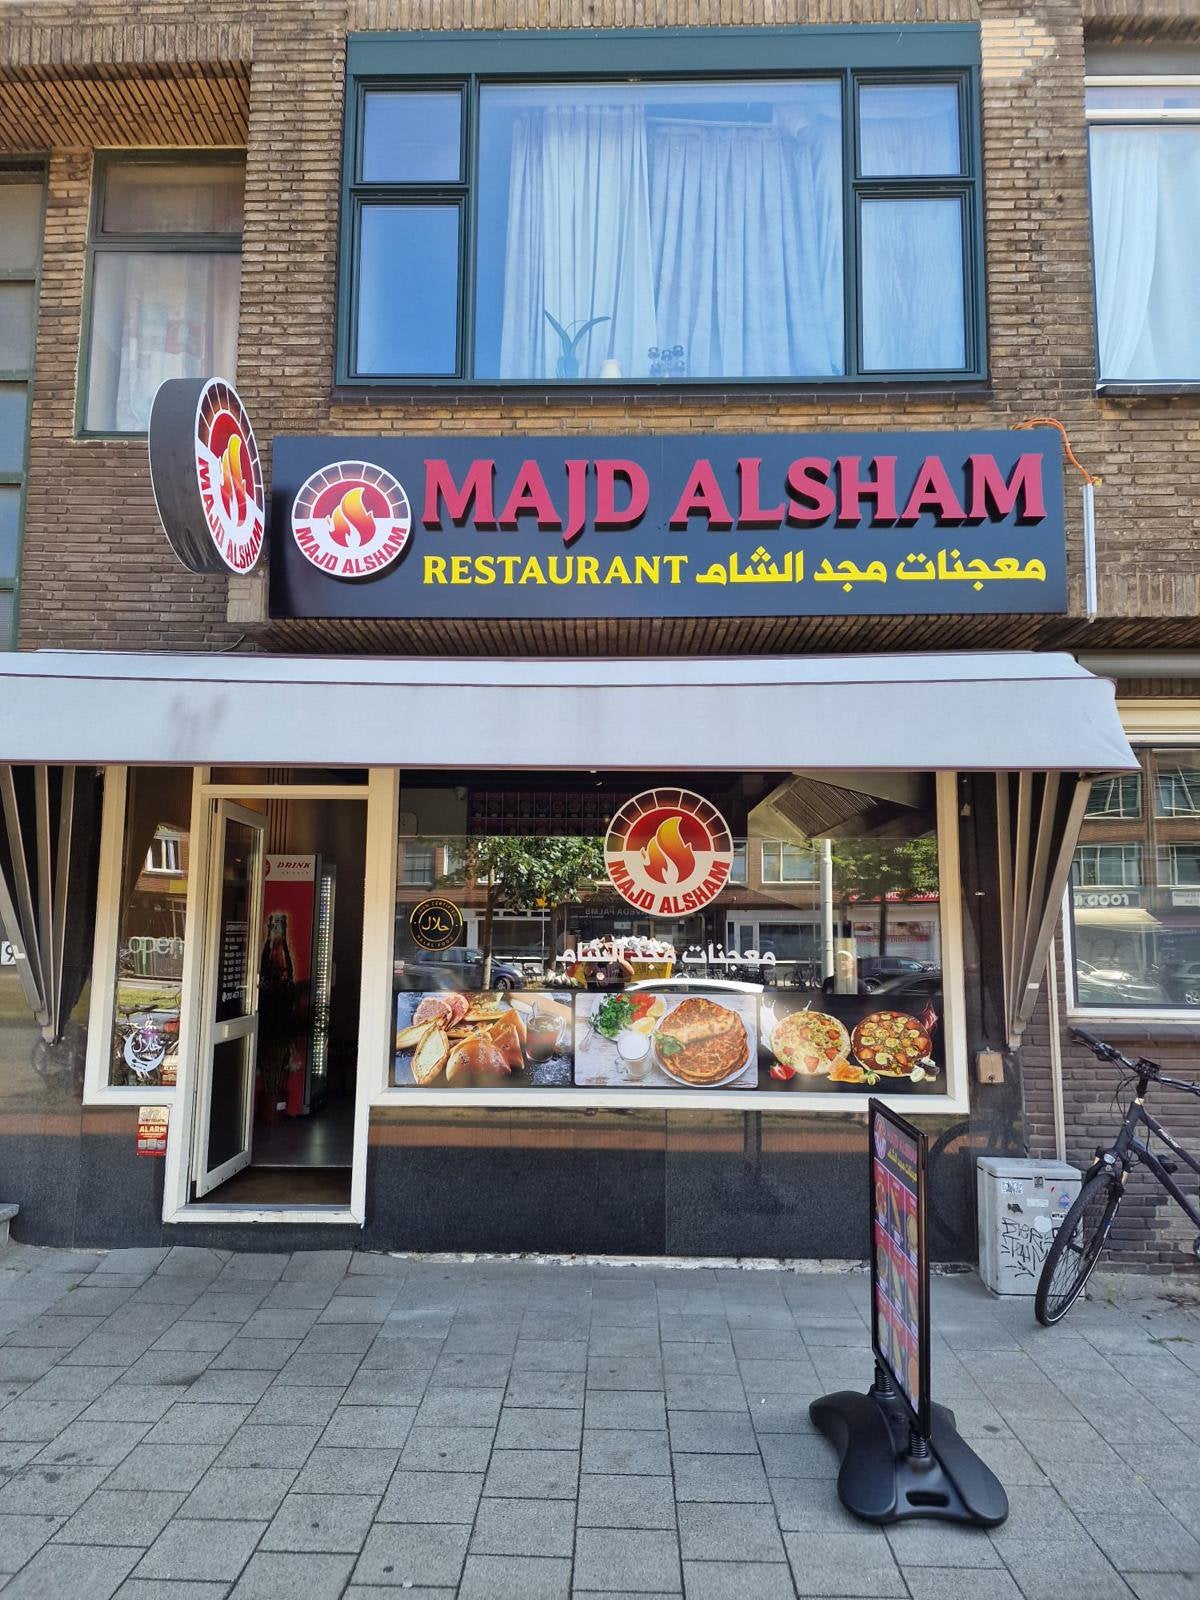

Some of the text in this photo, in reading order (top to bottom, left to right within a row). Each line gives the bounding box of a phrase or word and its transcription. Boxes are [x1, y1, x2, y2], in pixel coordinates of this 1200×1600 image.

[198, 457, 263, 569] MAJD ALSHAM
[422, 453, 1048, 542] MAJD ALSHAM
[295, 526, 407, 574] MAJD ALSHAM
[695, 545, 1047, 593] معجنات مجد الشام
[423, 556, 688, 585] RESTAURANT
[277, 861, 312, 869] DRINK
[607, 860, 730, 914] MAJD ALSHAM
[421, 915, 450, 931] حلال
[682, 943, 777, 972] معجنات
[139, 1125, 167, 1133] ALARM
